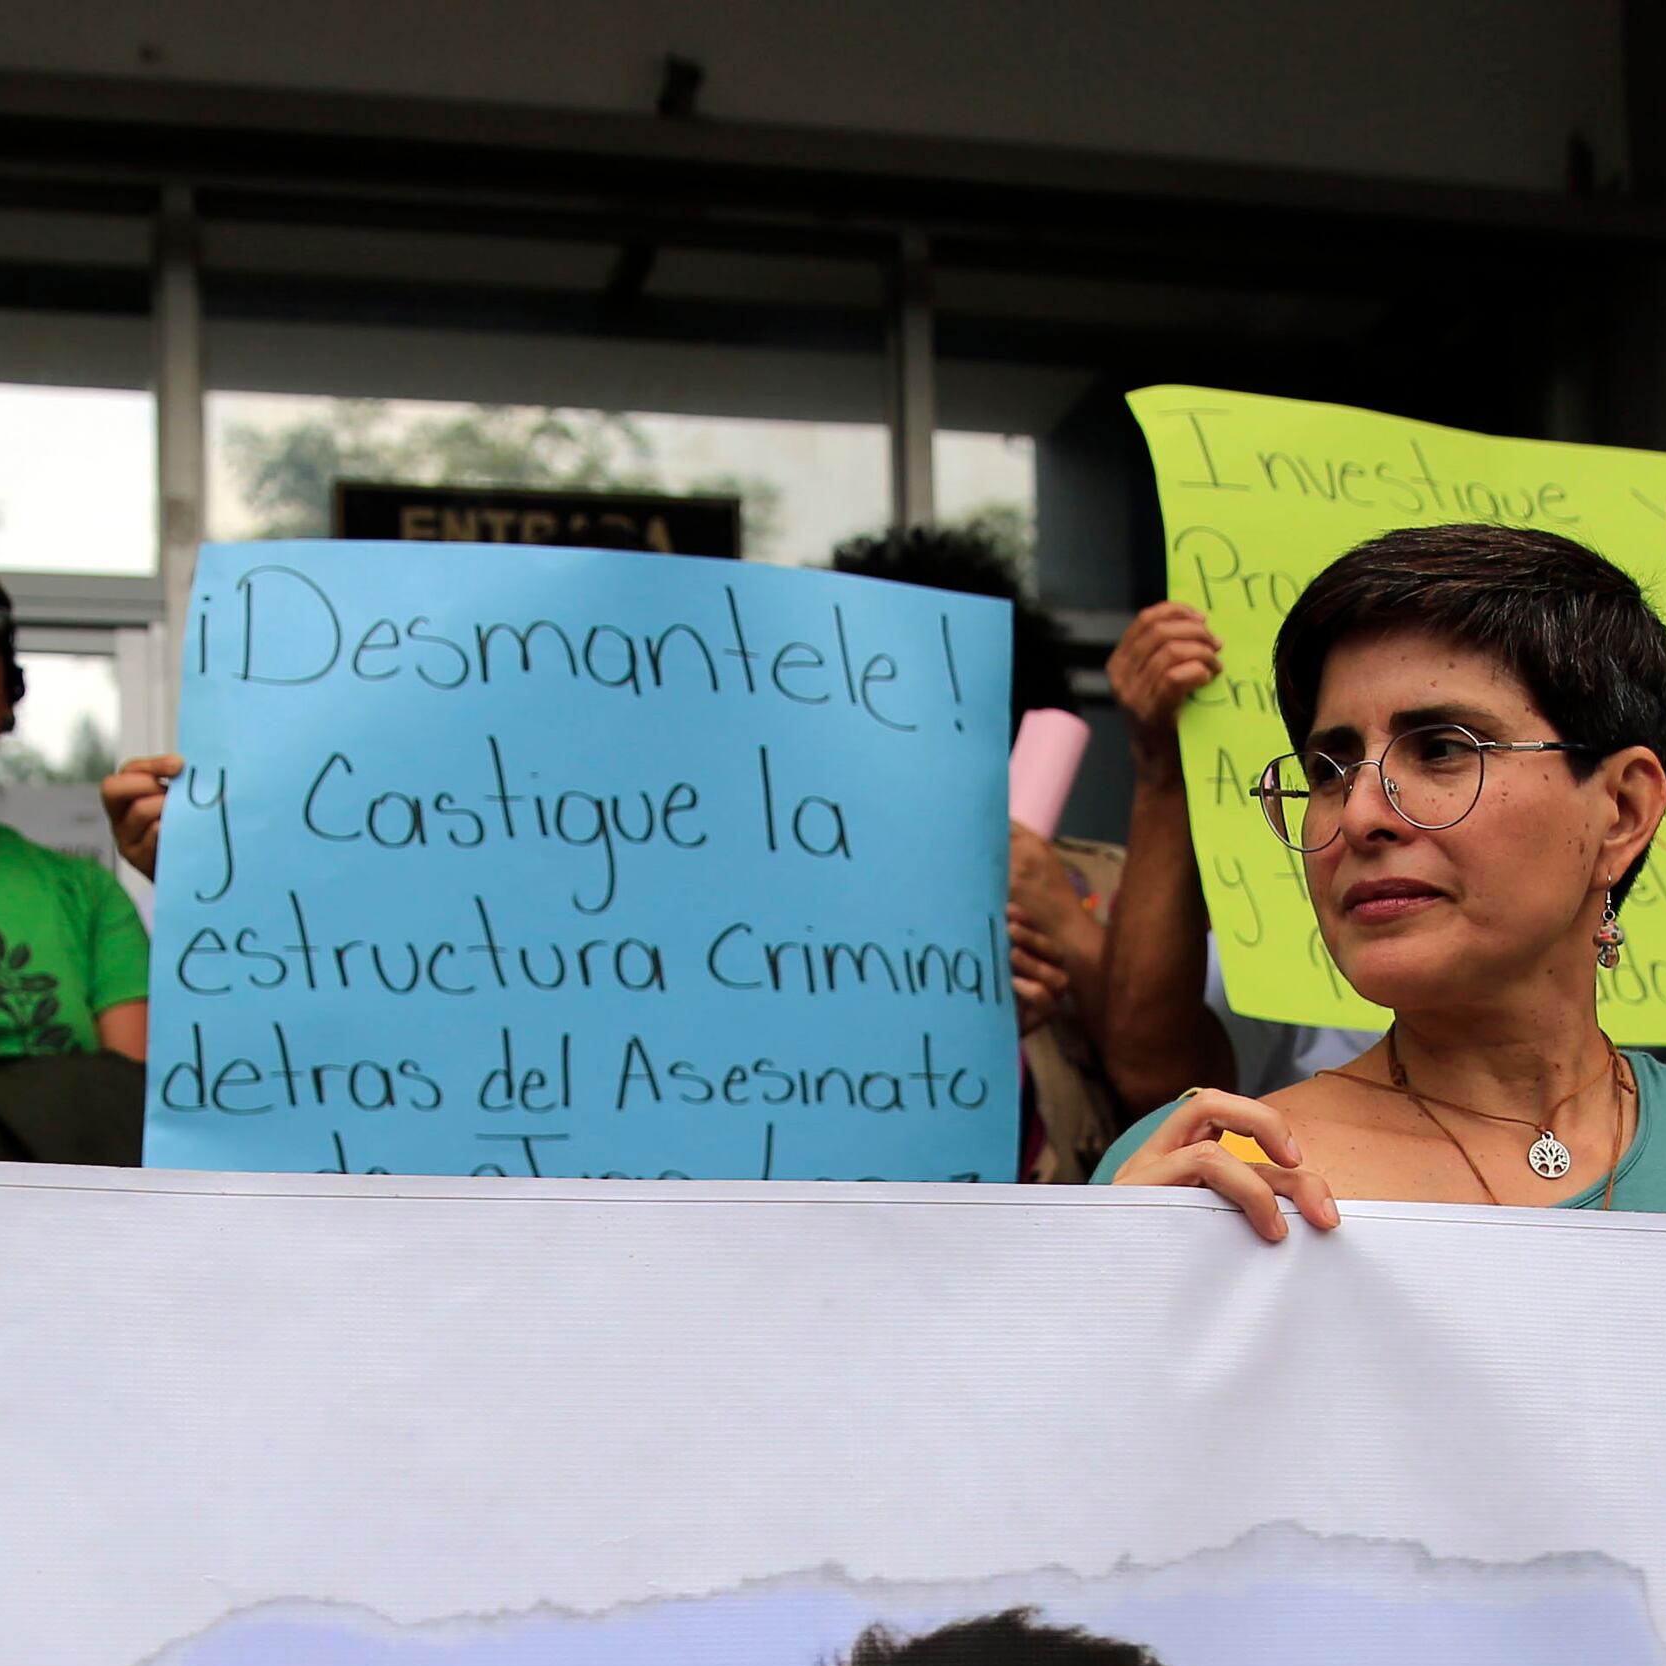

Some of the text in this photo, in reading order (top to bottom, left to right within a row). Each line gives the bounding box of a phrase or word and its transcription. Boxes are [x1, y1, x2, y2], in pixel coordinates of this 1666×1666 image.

[303, 734, 710, 915] Castigue
[757, 744, 853, 861] la
[176, 888, 667, 997] estructura
[160, 1021, 991, 1115] detras del Asesinato
